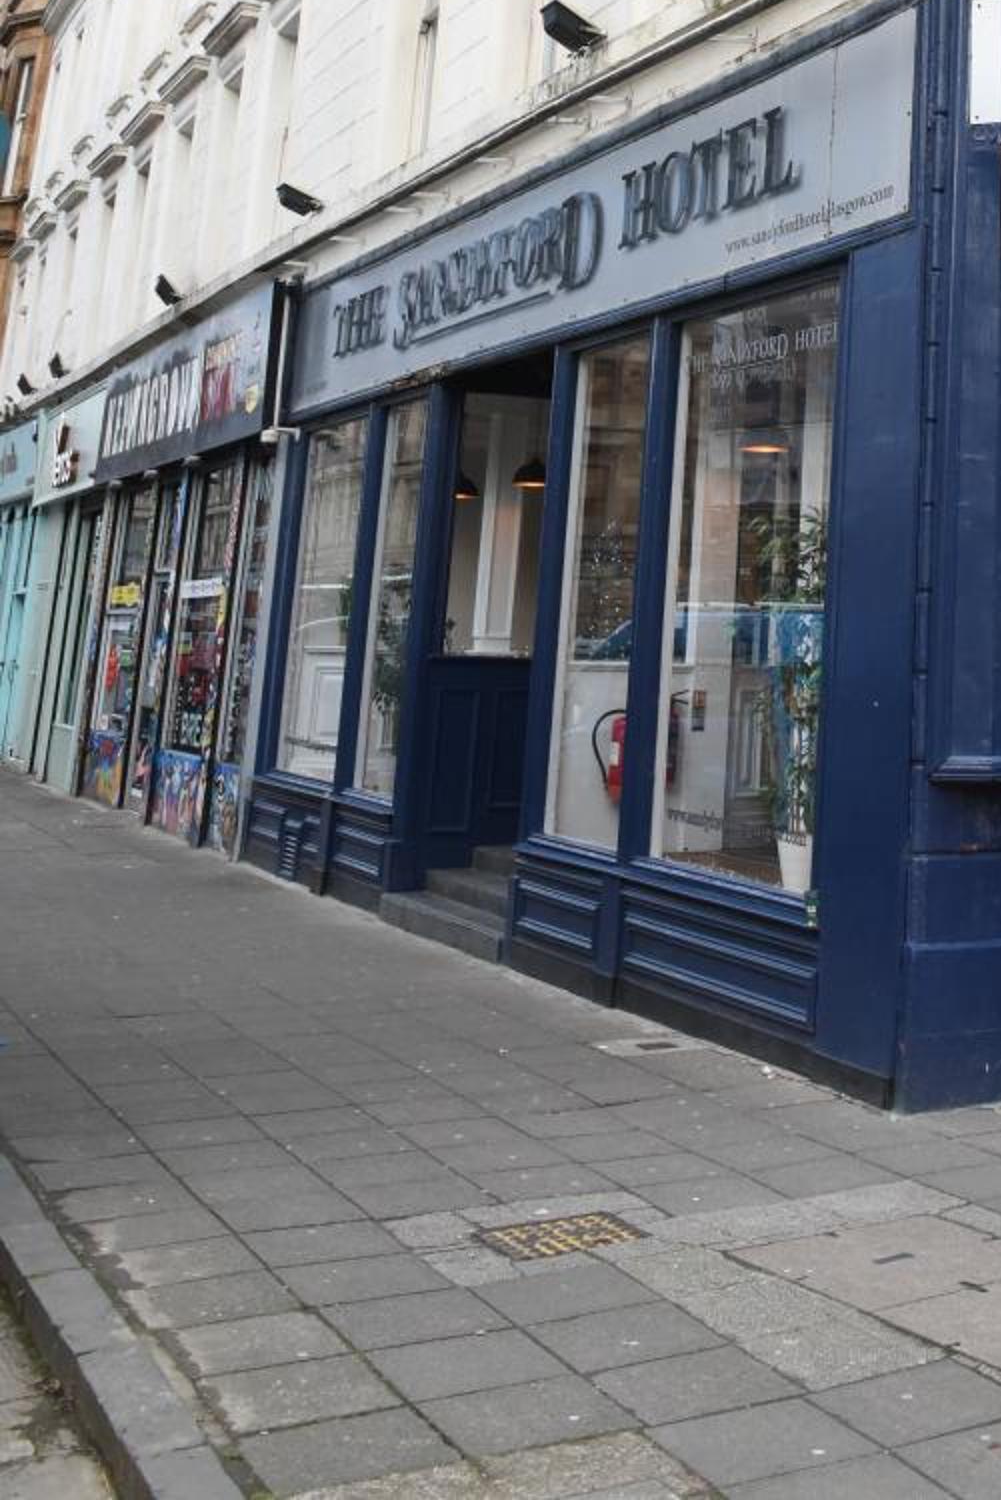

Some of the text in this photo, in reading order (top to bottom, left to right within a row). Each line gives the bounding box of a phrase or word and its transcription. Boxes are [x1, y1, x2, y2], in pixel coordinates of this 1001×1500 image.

[332, 105, 803, 358] THE SANDYFORD HOTEL
